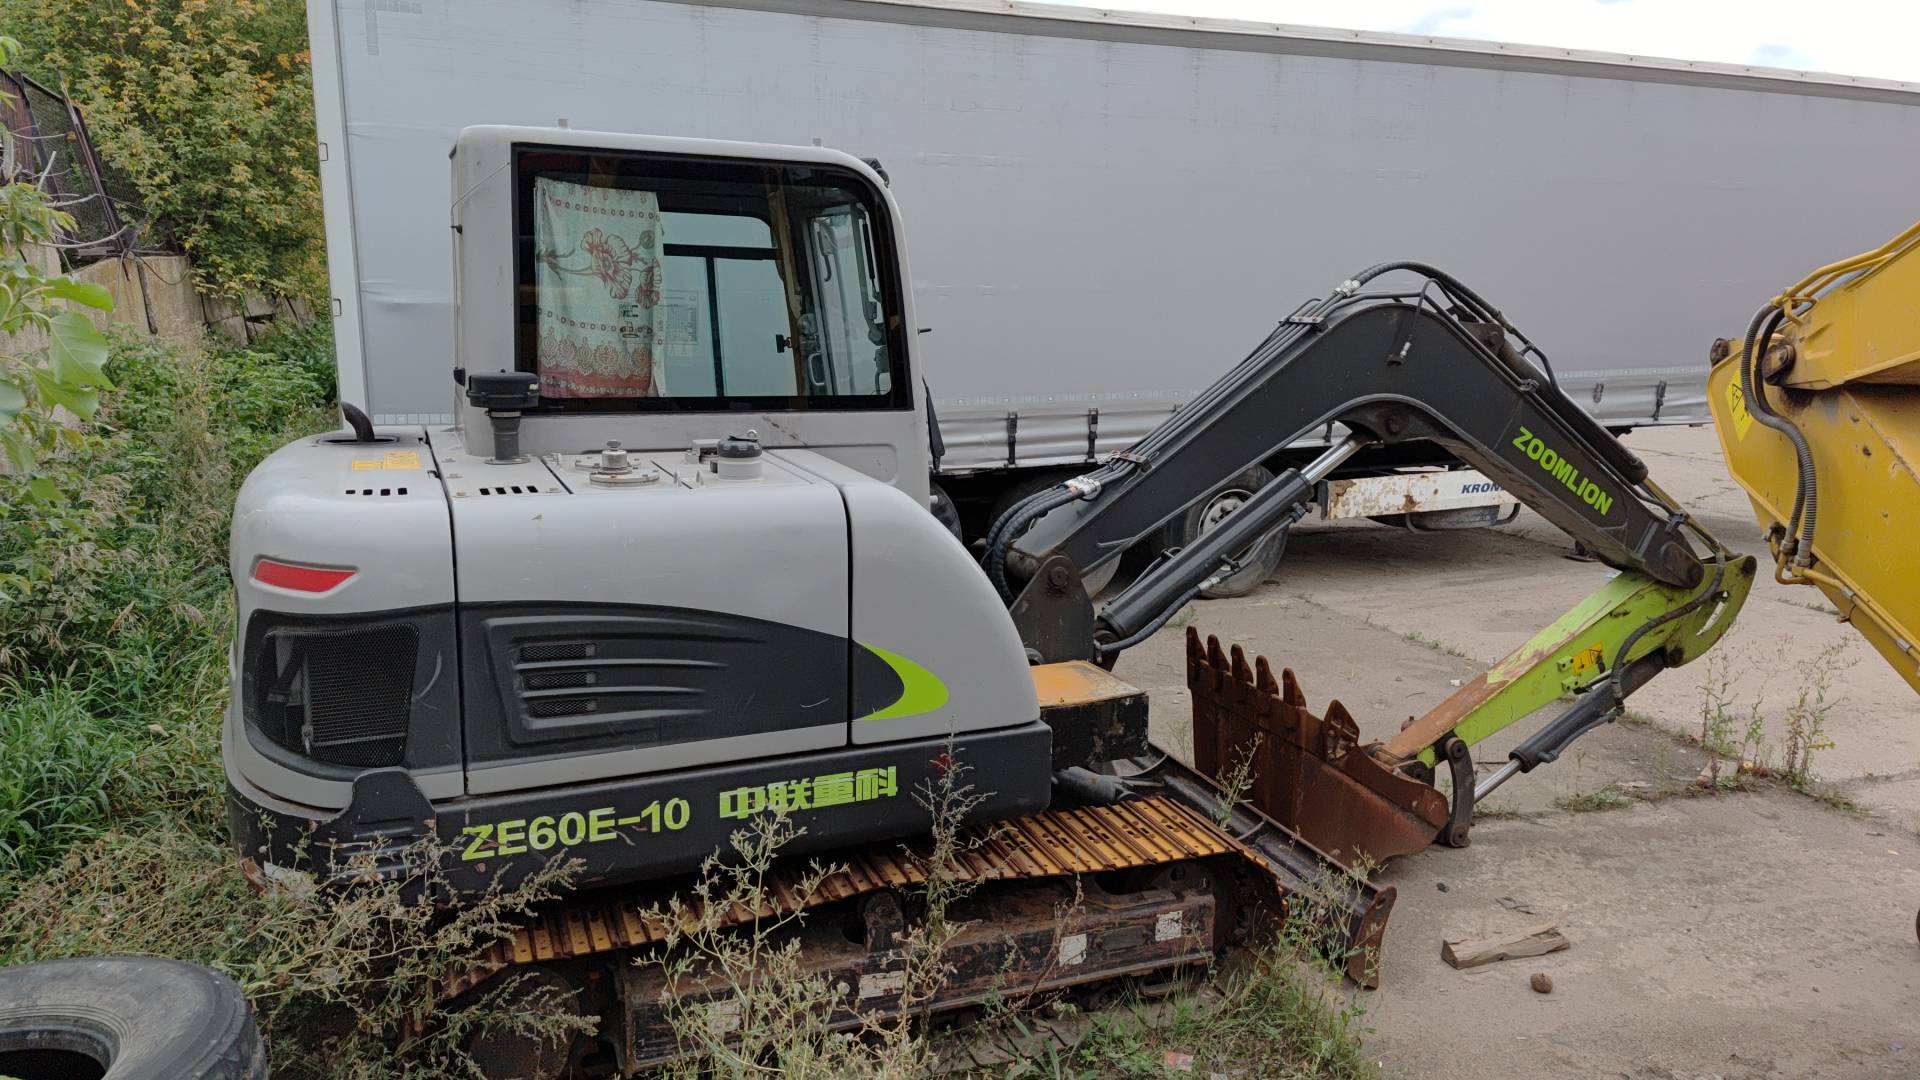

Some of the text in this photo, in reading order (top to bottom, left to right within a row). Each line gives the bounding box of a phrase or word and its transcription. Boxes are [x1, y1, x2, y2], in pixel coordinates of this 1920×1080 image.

[1461, 482, 1504, 494] KRON
[1512, 426, 1614, 516] ZOOMLION
[719, 766, 898, 820] 中联重科
[461, 797, 691, 861] ZE60E-10
